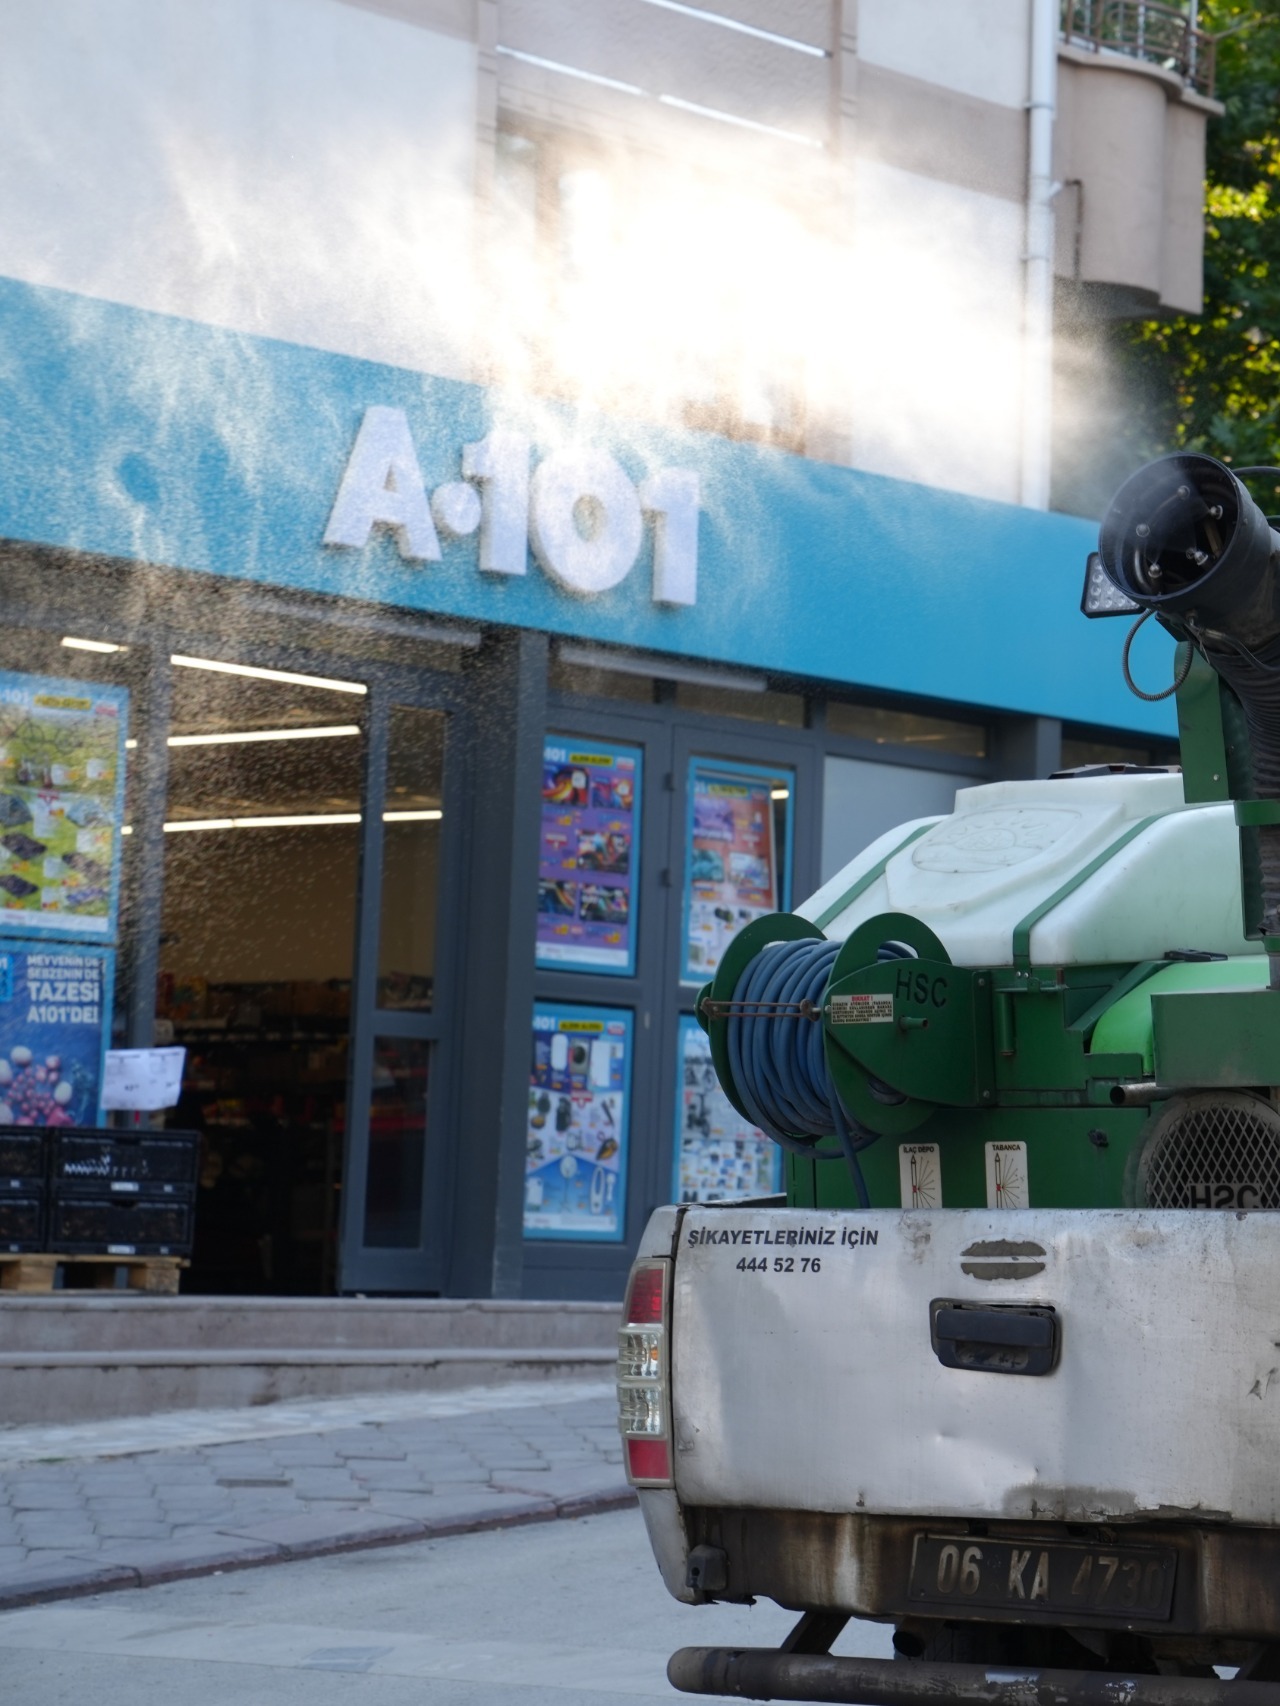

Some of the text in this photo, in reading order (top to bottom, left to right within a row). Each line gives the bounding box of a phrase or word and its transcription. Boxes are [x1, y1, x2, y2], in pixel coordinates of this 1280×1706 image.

[27, 981, 99, 1002] TAZESİ
[896, 969, 947, 1008] HSC
[687, 1226, 879, 1249] ŞİKAYETLERİNİZ İÇİN
[736, 1257, 821, 1273] 444 52 76
[937, 1545, 983, 1595] 06
[1008, 1549, 1050, 1600] KA
